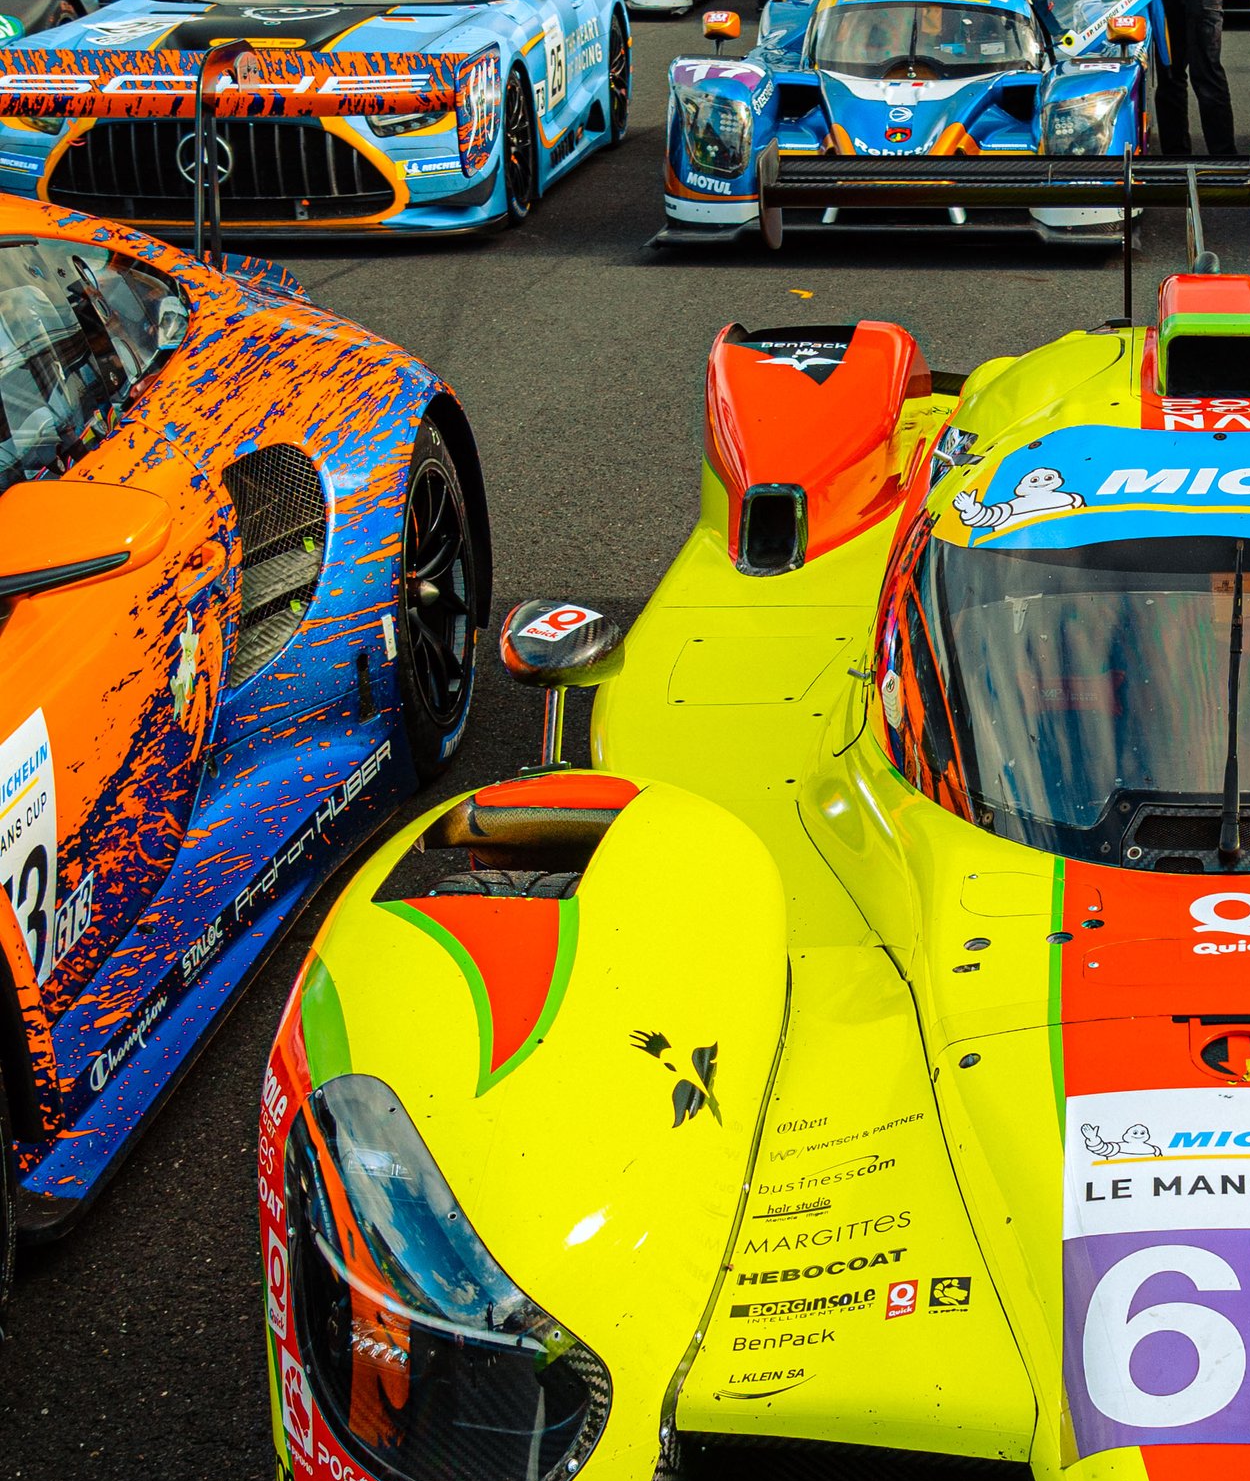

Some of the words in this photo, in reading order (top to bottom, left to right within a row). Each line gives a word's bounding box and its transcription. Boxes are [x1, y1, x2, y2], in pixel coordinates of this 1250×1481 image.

[550, 43, 564, 98] 25
[535, 86, 546, 113] T3
[422, 160, 461, 171] MICHEL
[686, 171, 732, 196] MOTUL
[761, 341, 848, 350] BenPack
[526, 626, 558, 639] Quick
[0, 819, 23, 858] ANS
[26, 791, 48, 828] CUP
[2, 844, 48, 982] 3
[55, 879, 92, 957] GT3
[90, 993, 168, 1092] Champion
[777, 1117, 828, 1135] Olden
[806, 1133, 859, 1153] WINTSCH
[862, 1130, 870, 1139] &
[872, 1112, 924, 1135] PARTNER
[758, 1157, 896, 1195] businesscom
[1085, 1178, 1132, 1202] LE
[767, 1202, 791, 1215] hair
[796, 1197, 832, 1213] studio
[736, 1248, 908, 1286] HEBOCOAT
[270, 1308, 285, 1331] Quick
[747, 1309, 834, 1324] INTELLIGENT
[888, 1306, 913, 1317] Quick
[732, 1329, 836, 1352] BenPack
[728, 1369, 783, 1385] L.KLEIN
[786, 1367, 805, 1380] SA
